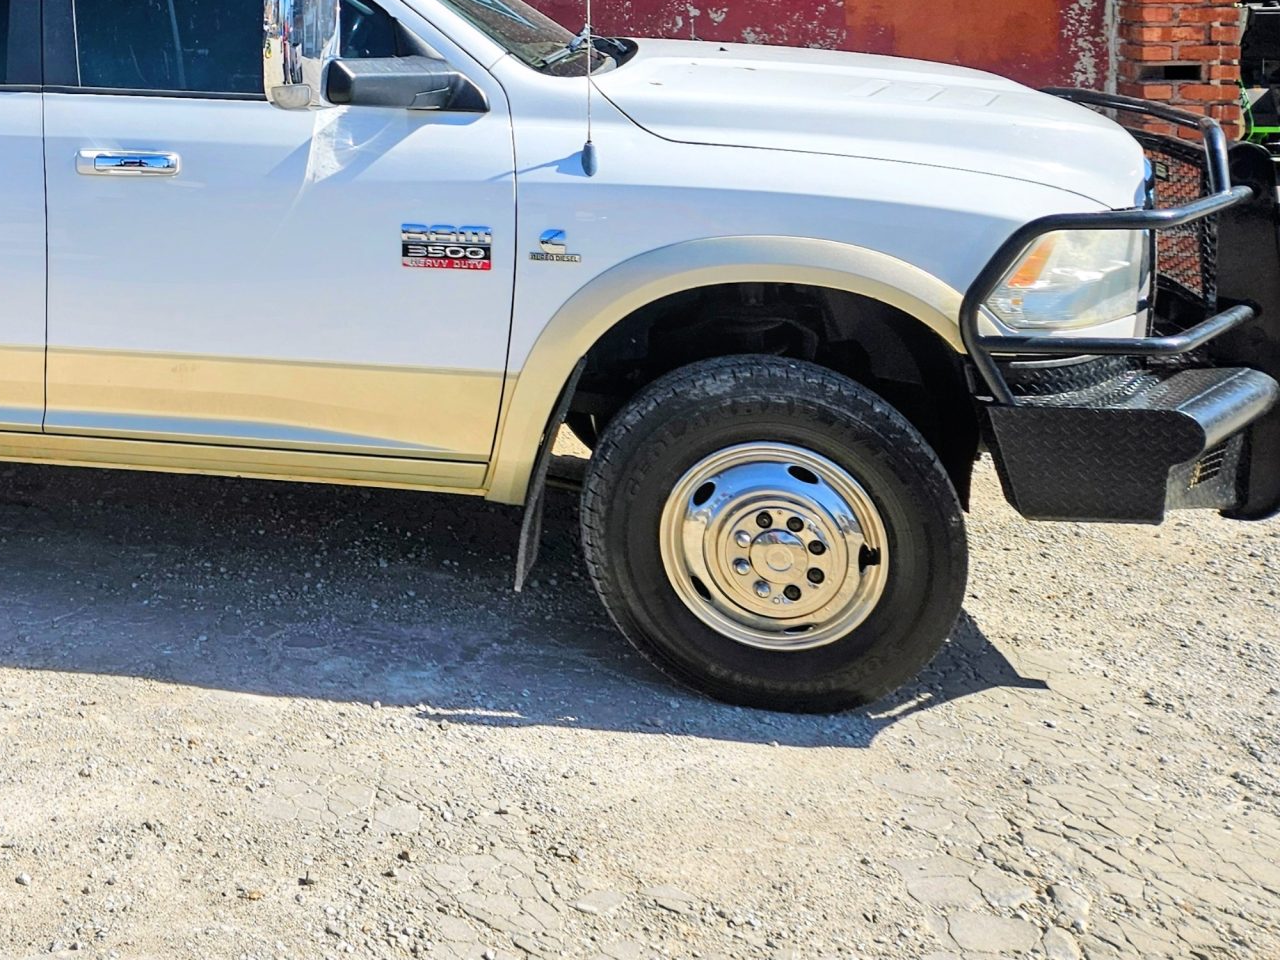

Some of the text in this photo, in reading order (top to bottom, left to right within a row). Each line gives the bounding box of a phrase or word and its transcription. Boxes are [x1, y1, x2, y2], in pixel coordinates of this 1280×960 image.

[401, 224, 492, 243] RAM
[407, 245, 485, 259] 3500
[410, 259, 483, 269] HEAVY DUTY
